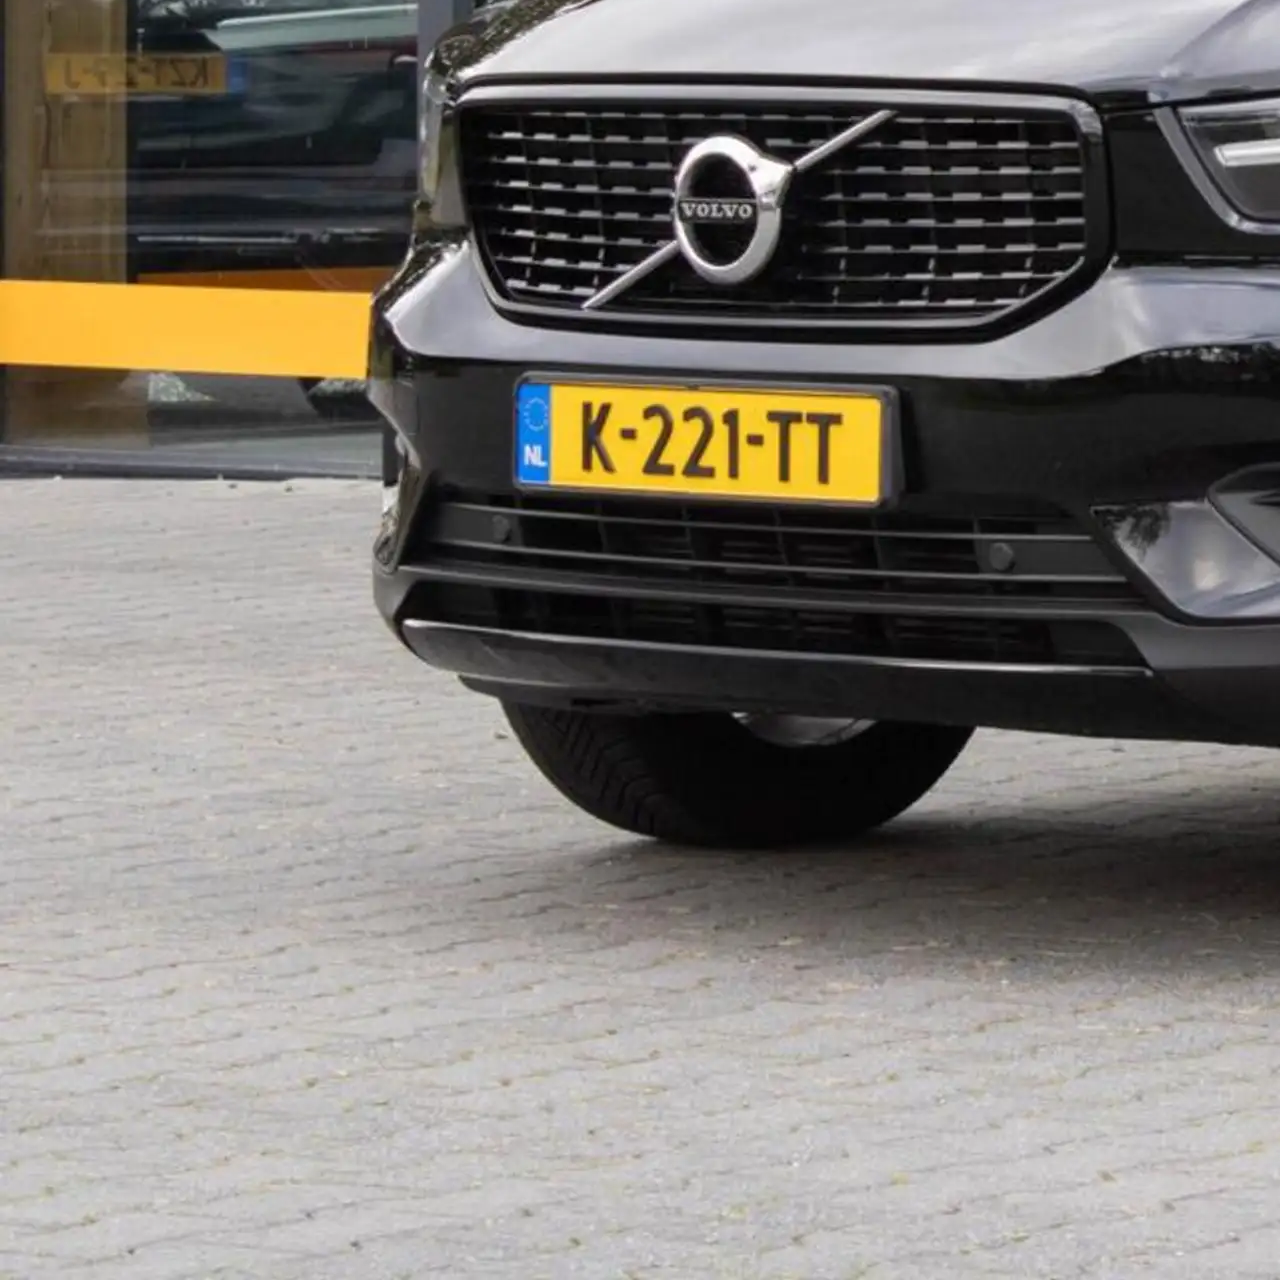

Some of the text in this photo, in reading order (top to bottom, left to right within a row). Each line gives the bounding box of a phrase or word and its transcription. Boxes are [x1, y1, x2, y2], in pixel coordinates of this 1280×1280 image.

[680, 202, 753, 219] VOLVO
[523, 400, 843, 485] NL K-221-TT
